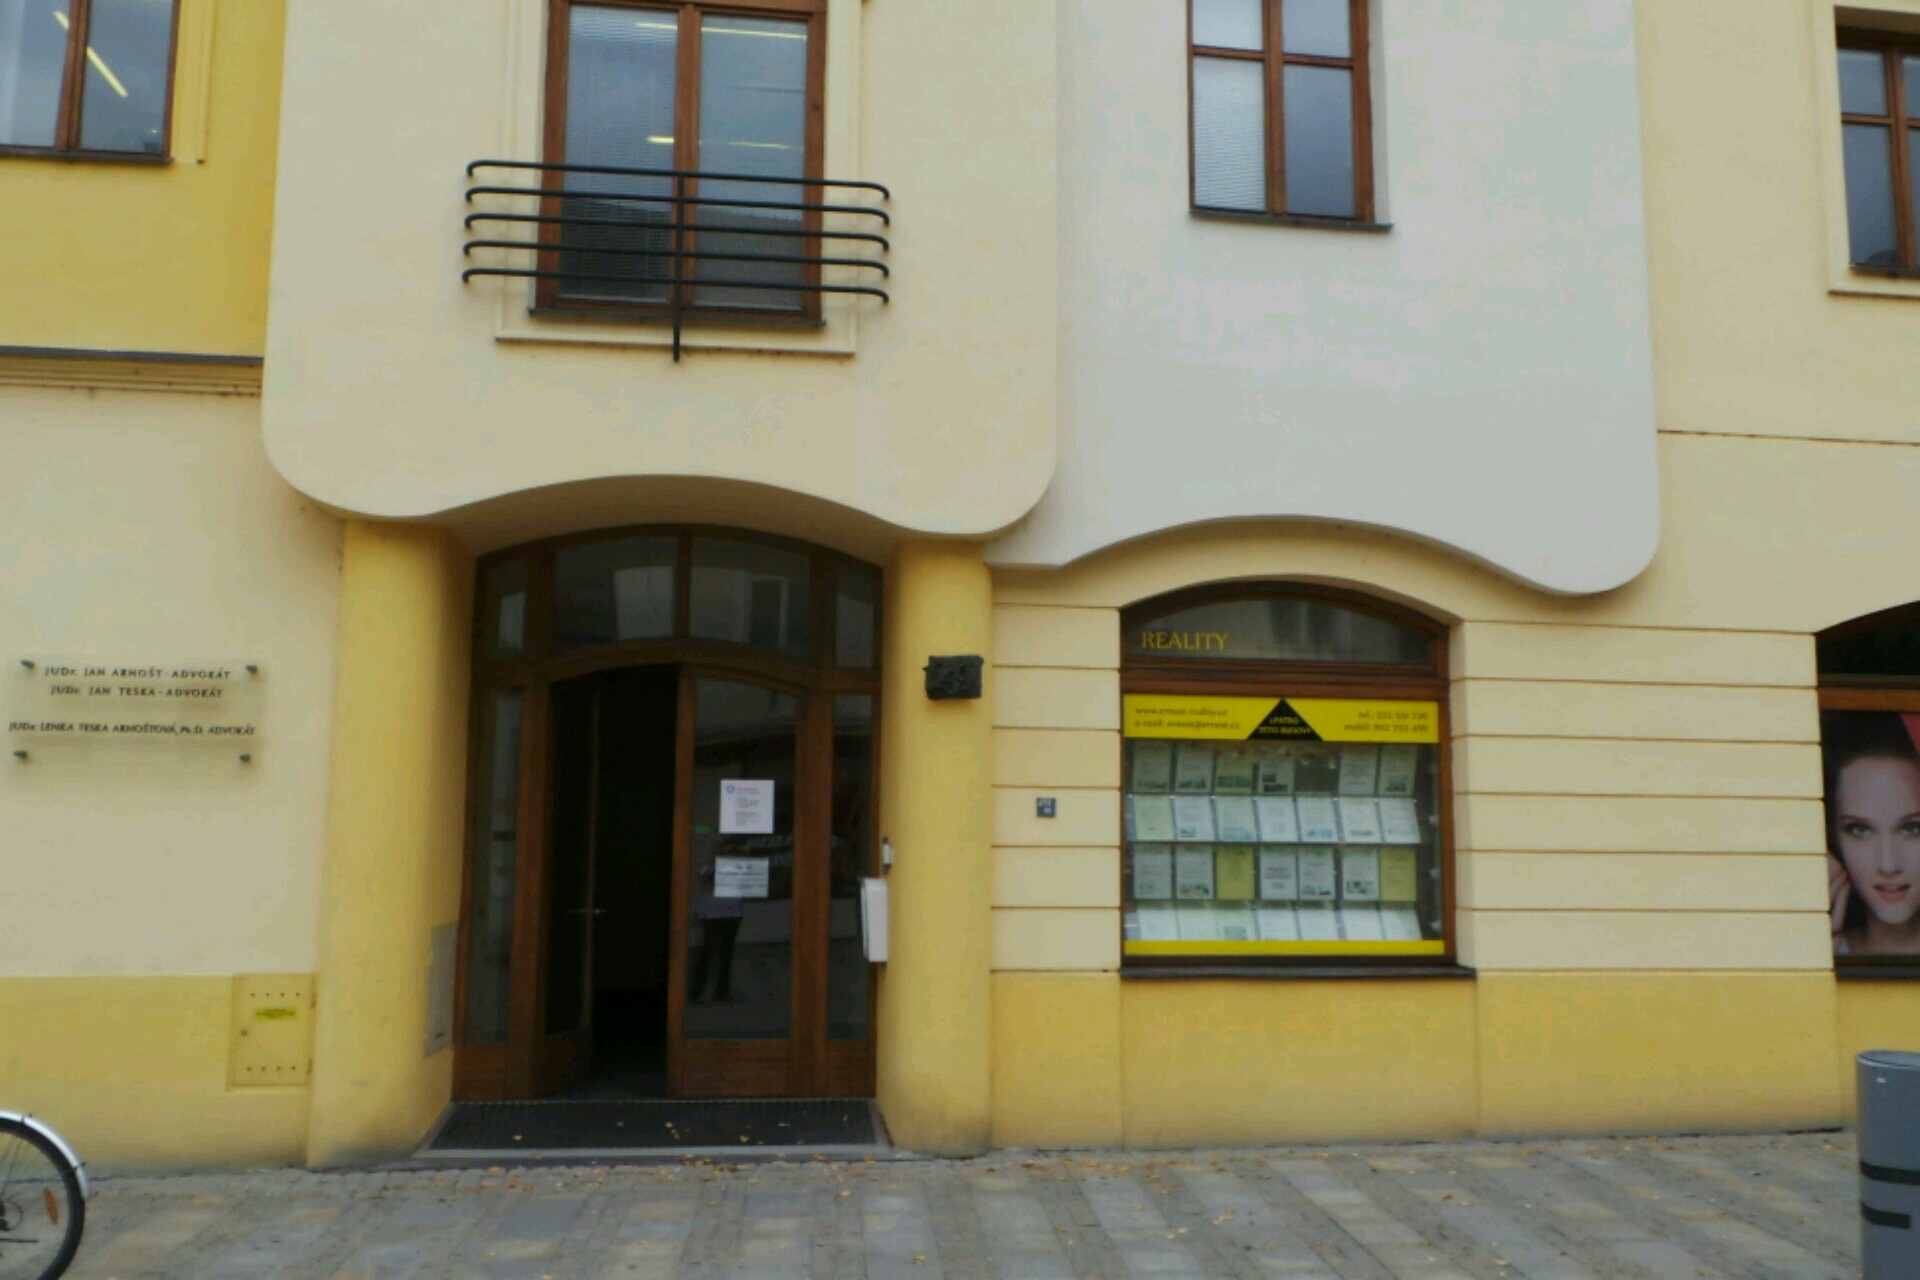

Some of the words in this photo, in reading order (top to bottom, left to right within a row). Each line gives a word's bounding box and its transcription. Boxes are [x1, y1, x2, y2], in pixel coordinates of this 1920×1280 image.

[1142, 632, 1228, 651] REALITY
[84, 668, 105, 677] JAN
[88, 687, 111, 696] JAN
